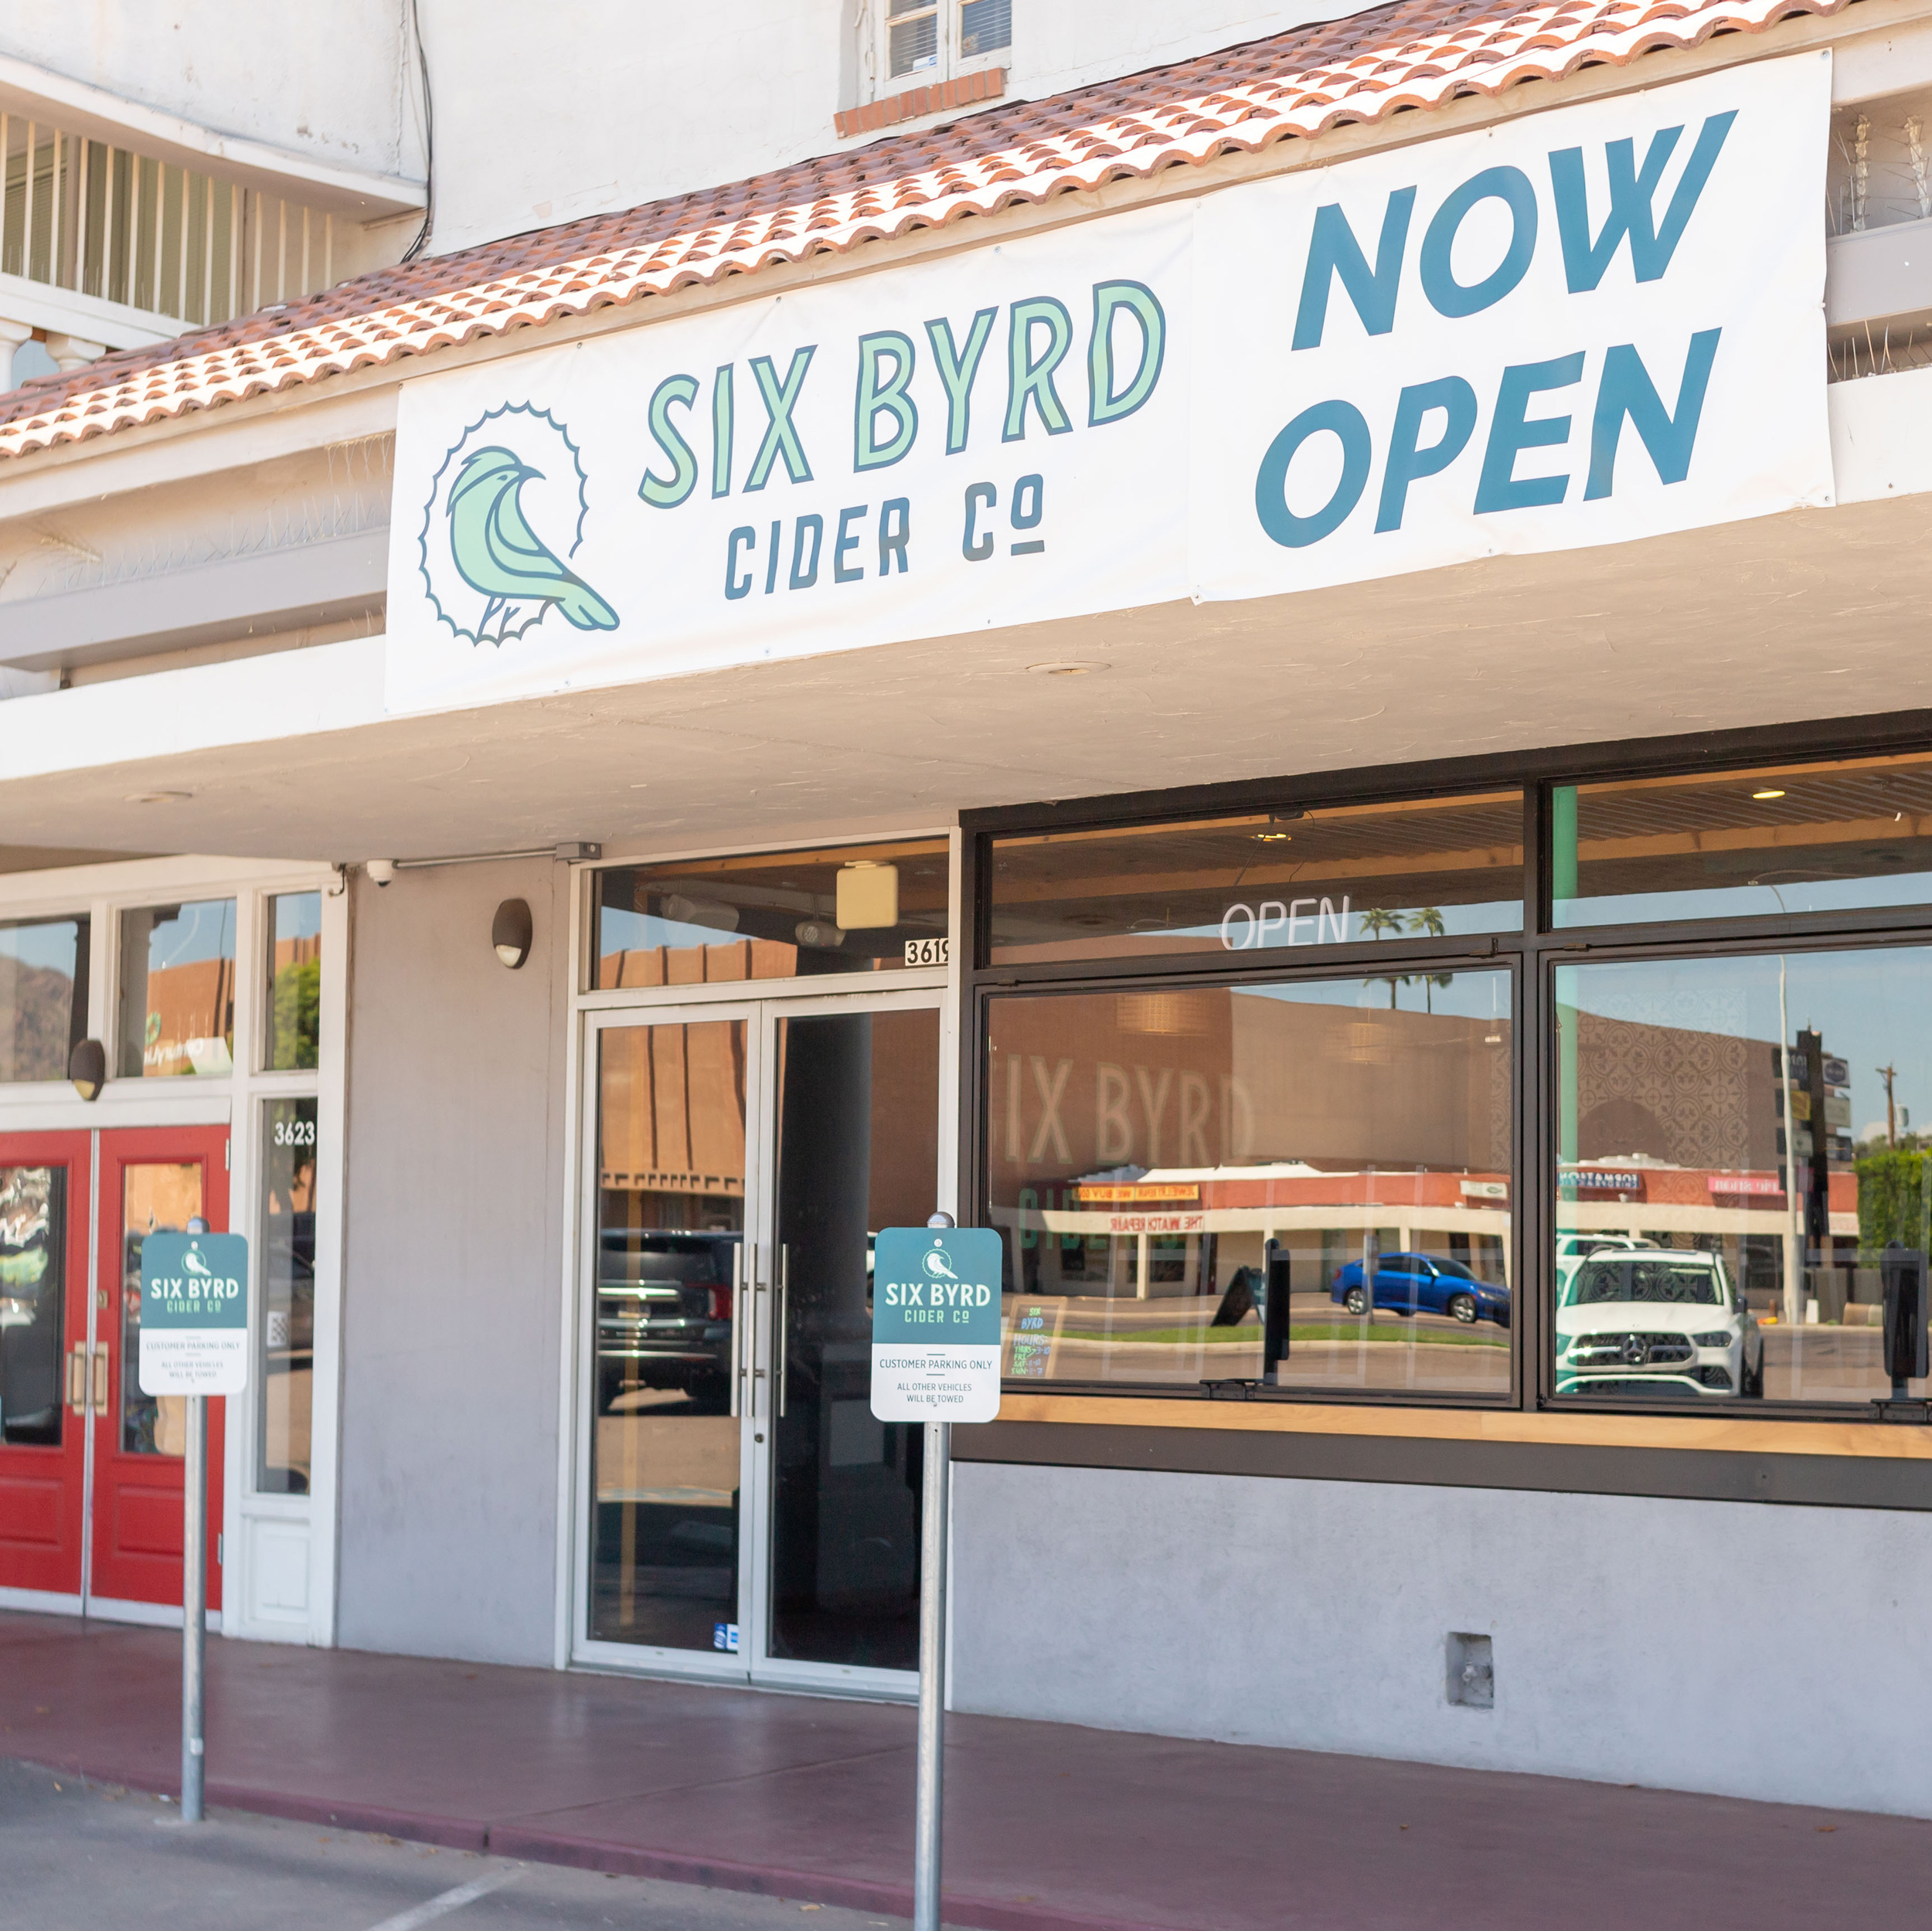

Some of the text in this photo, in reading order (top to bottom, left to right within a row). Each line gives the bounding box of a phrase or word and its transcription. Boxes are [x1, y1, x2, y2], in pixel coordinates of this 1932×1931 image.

[1291, 109, 1740, 352] NOW
[638, 279, 1166, 510] SIX BYRD
[1255, 327, 1723, 548] OPEN
[725, 497, 910, 600] CIDER
[1221, 896, 1349, 950] OPEN
[907, 940, 948, 964] 3619
[1096, 1062, 1256, 1168] BYRD
[274, 1120, 315, 1146] 3623
[151, 1278, 239, 1299] SIX BYRD
[885, 1283, 991, 1307] SIX BYRD
[167, 1300, 200, 1314] CIDER
[904, 1310, 944, 1323] CIDER
[1029, 1307, 1041, 1317] SIX
[1021, 1317, 1043, 1330] BYRD
[146, 1341, 240, 1350] CUSTOMER PARKING ONLY
[879, 1358, 992, 1370] CUSTOMER PARKING ONLY
[897, 1382, 972, 1392] ALL OTHER VEHICLES
[906, 1394, 924, 1402] WILL
[937, 1395, 964, 1403] TOWED
